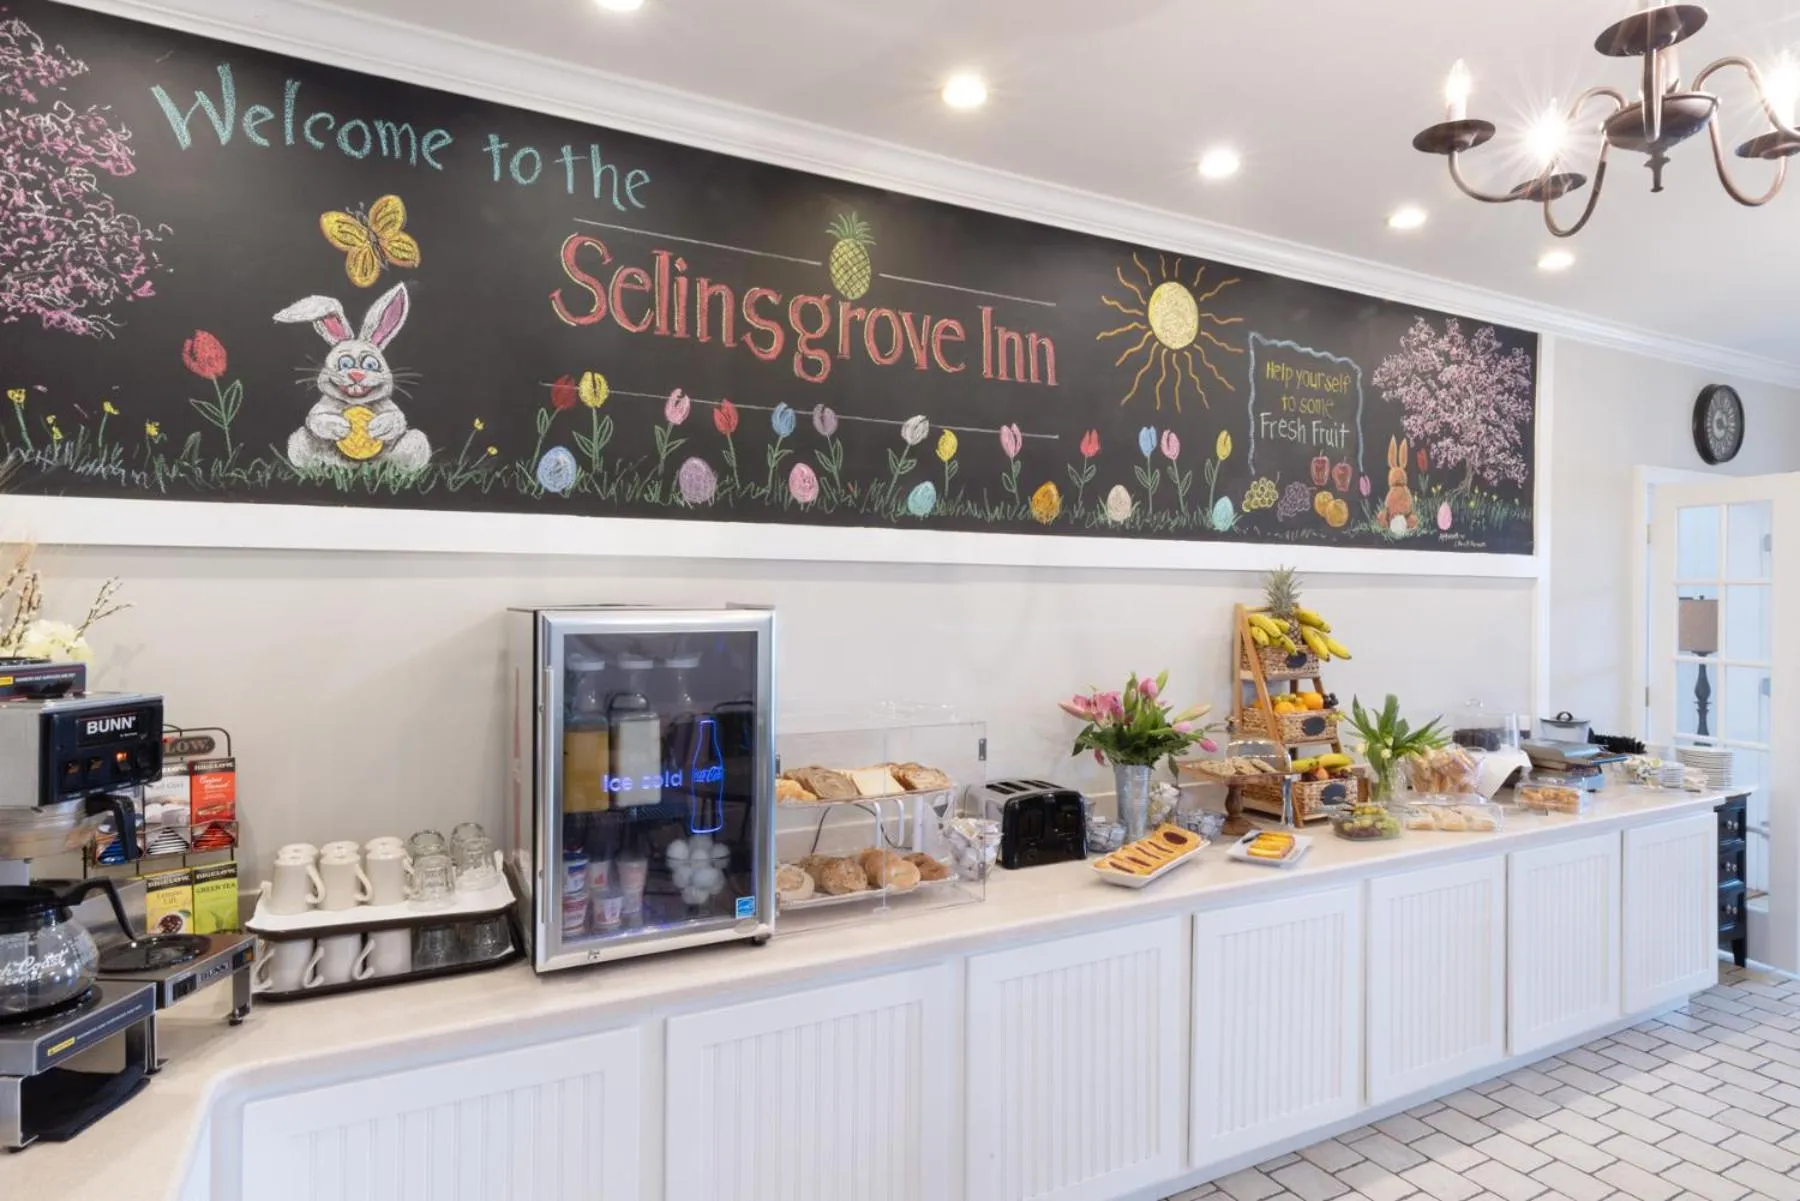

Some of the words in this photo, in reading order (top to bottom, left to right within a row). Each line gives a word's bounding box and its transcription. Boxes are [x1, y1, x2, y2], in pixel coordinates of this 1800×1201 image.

[150, 63, 453, 171] Welcome
[483, 134, 543, 185] to
[554, 143, 651, 211] the
[550, 232, 966, 383] Selinsgrove
[977, 305, 1059, 386] Inn
[1266, 361, 1293, 389] Help
[1295, 368, 1351, 394] yourself
[1280, 395, 1296, 412] to
[1298, 397, 1334, 419] some
[1259, 412, 1306, 444] Fresh
[1312, 420, 1350, 448] Fruit
[87, 716, 135, 735] BUNN
